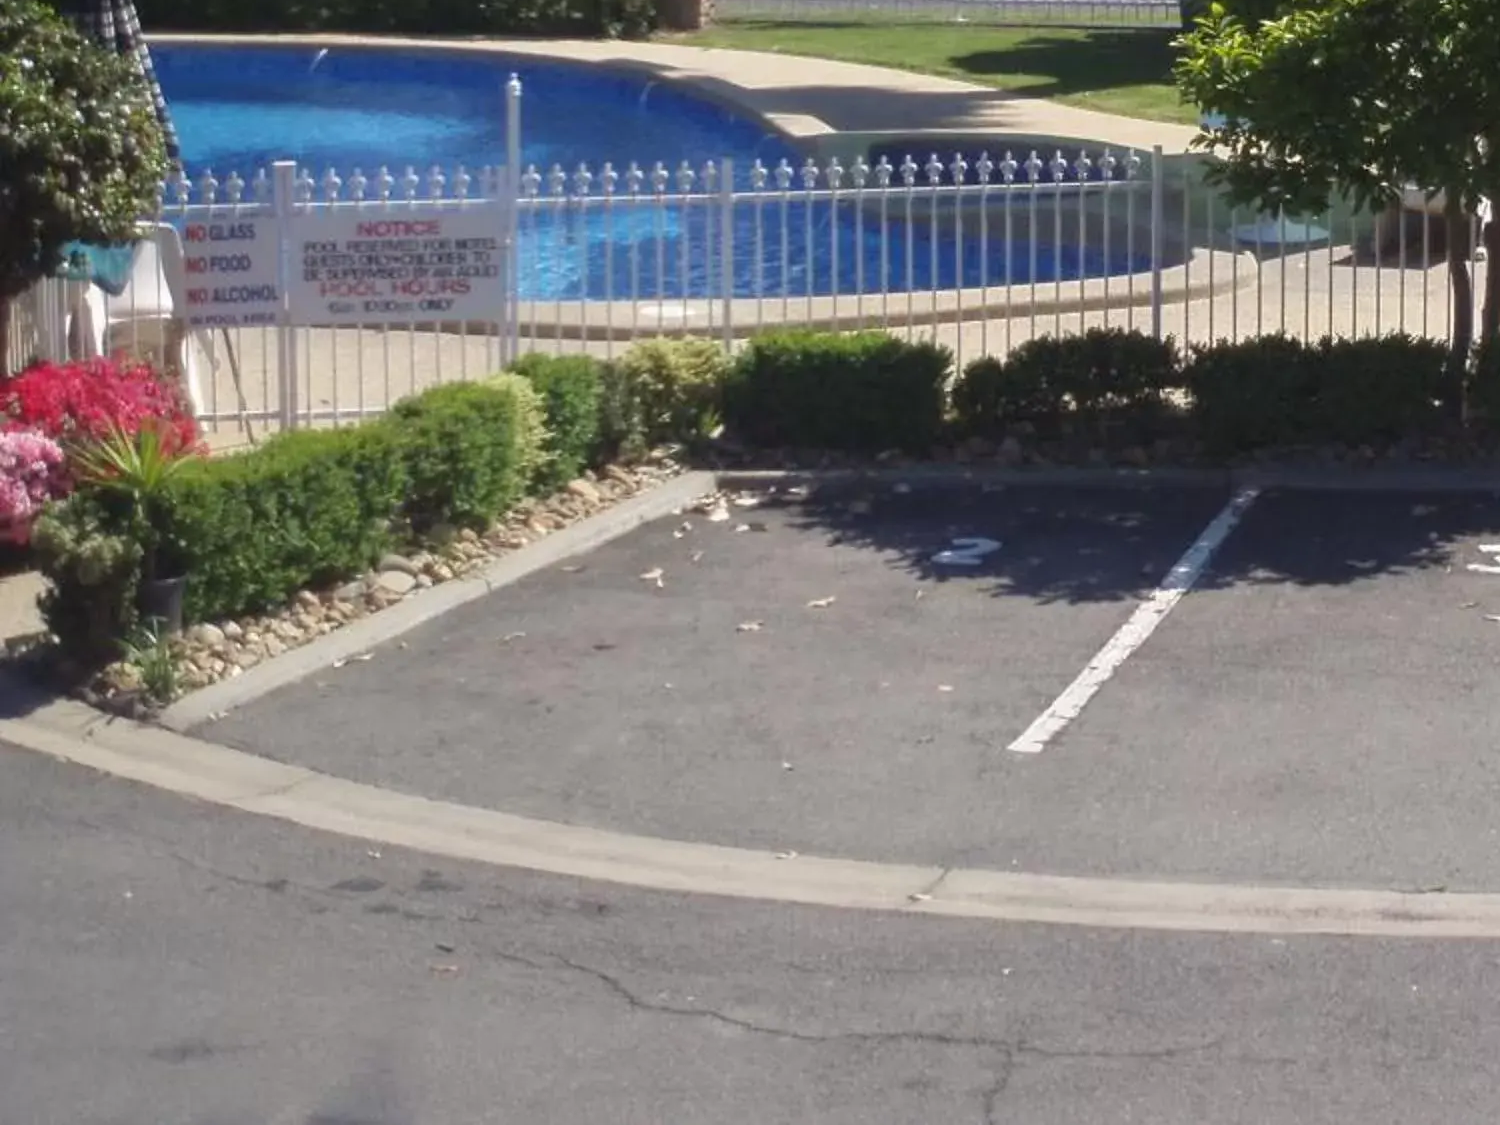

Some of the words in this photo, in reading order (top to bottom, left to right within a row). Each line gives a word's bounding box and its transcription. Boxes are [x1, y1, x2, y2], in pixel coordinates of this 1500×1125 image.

[185, 223, 207, 243] NO
[209, 222, 256, 241] GLASS
[356, 220, 440, 236] NOTICE
[303, 240, 338, 253] POOL
[346, 239, 419, 253] RESERVED
[423, 239, 452, 252] FOR
[186, 256, 208, 273] NO
[210, 254, 252, 272] FOOD
[303, 253, 355, 267] GUESTS
[473, 251, 490, 264] TO
[303, 268, 322, 281] BE
[186, 287, 208, 305] NO
[212, 283, 279, 303] ALCOHOL
[319, 280, 384, 296] POOL
[391, 278, 471, 295] HOURS
